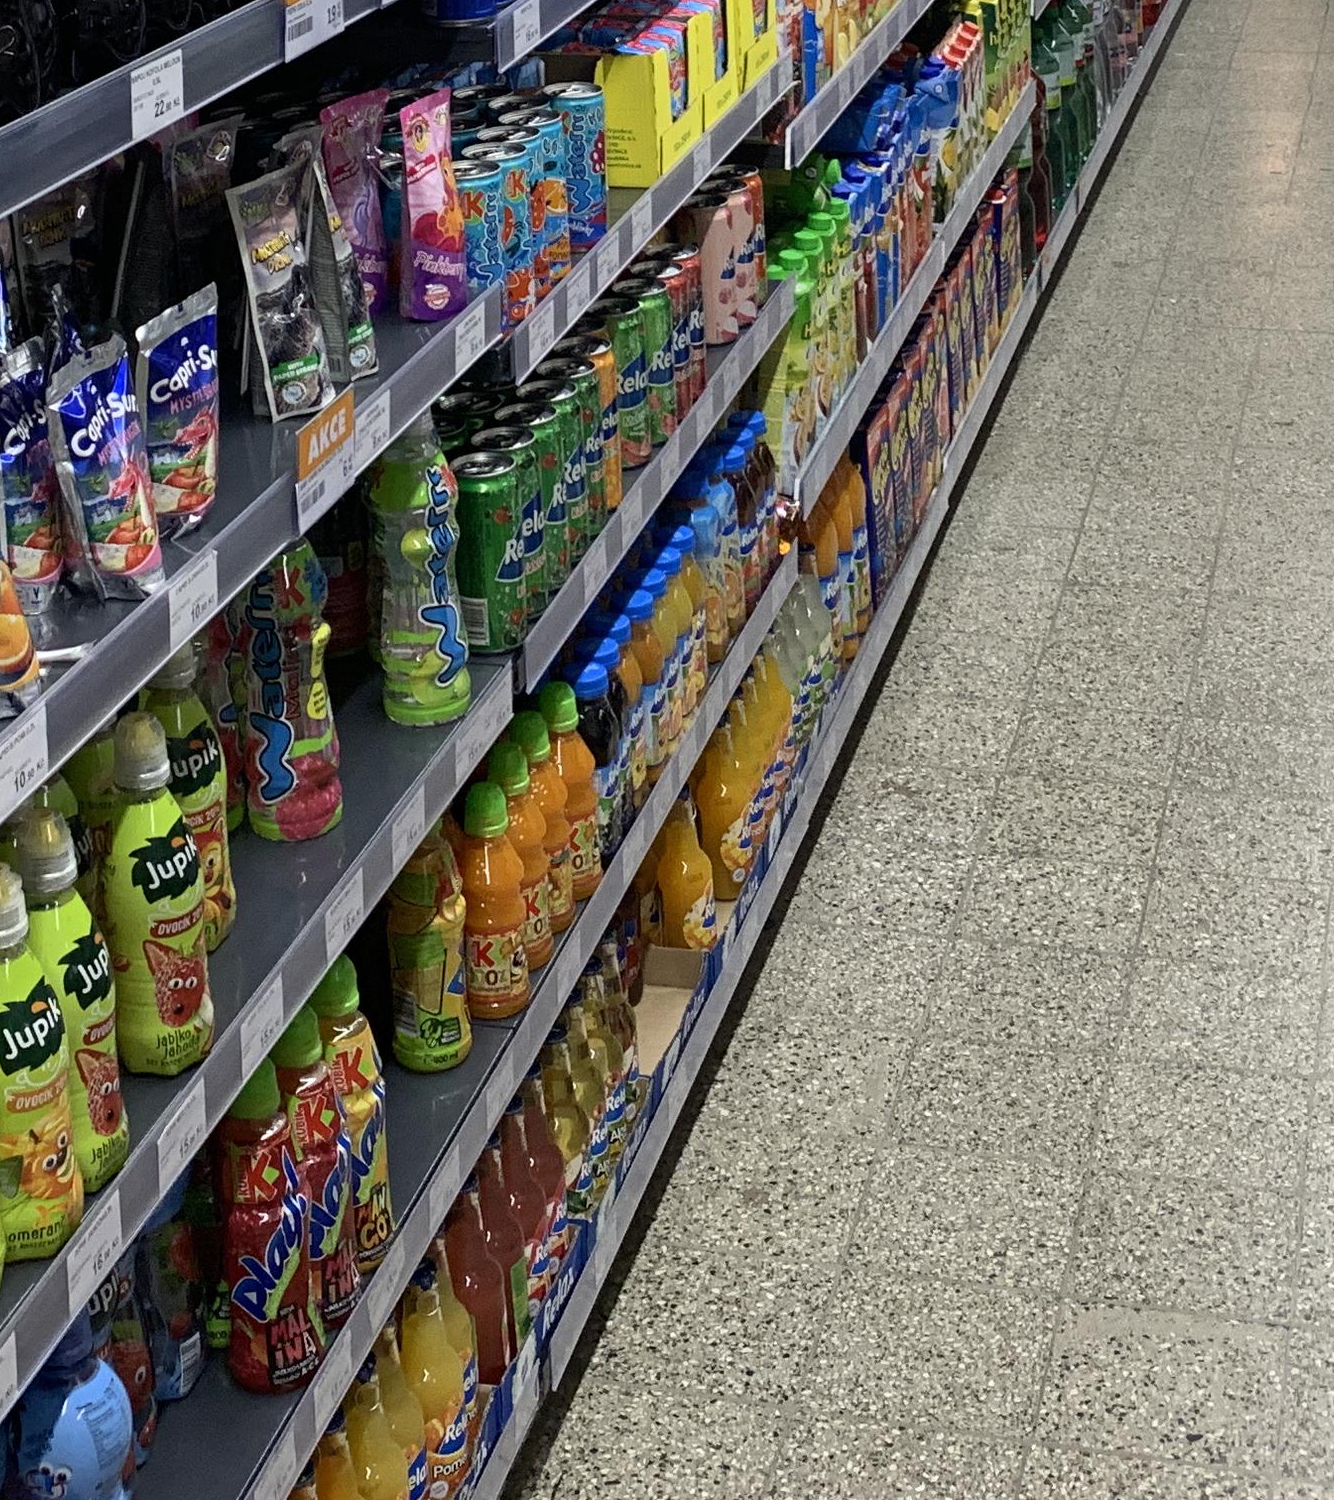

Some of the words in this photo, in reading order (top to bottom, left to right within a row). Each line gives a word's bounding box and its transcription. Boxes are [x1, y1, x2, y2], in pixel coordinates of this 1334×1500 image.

[150, 342, 218, 404] Capri-Su
[3, 400, 47, 457] Capri-S
[307, 407, 347, 466] AKCE
[147, 833, 199, 890] Jupik
[78, 949, 108, 994] Jup
[473, 940, 497, 969] K
[3, 996, 62, 1060] Jupik
[297, 1093, 336, 1148] K
[238, 1150, 278, 1203] K
[8, 1214, 63, 1243] omeran
